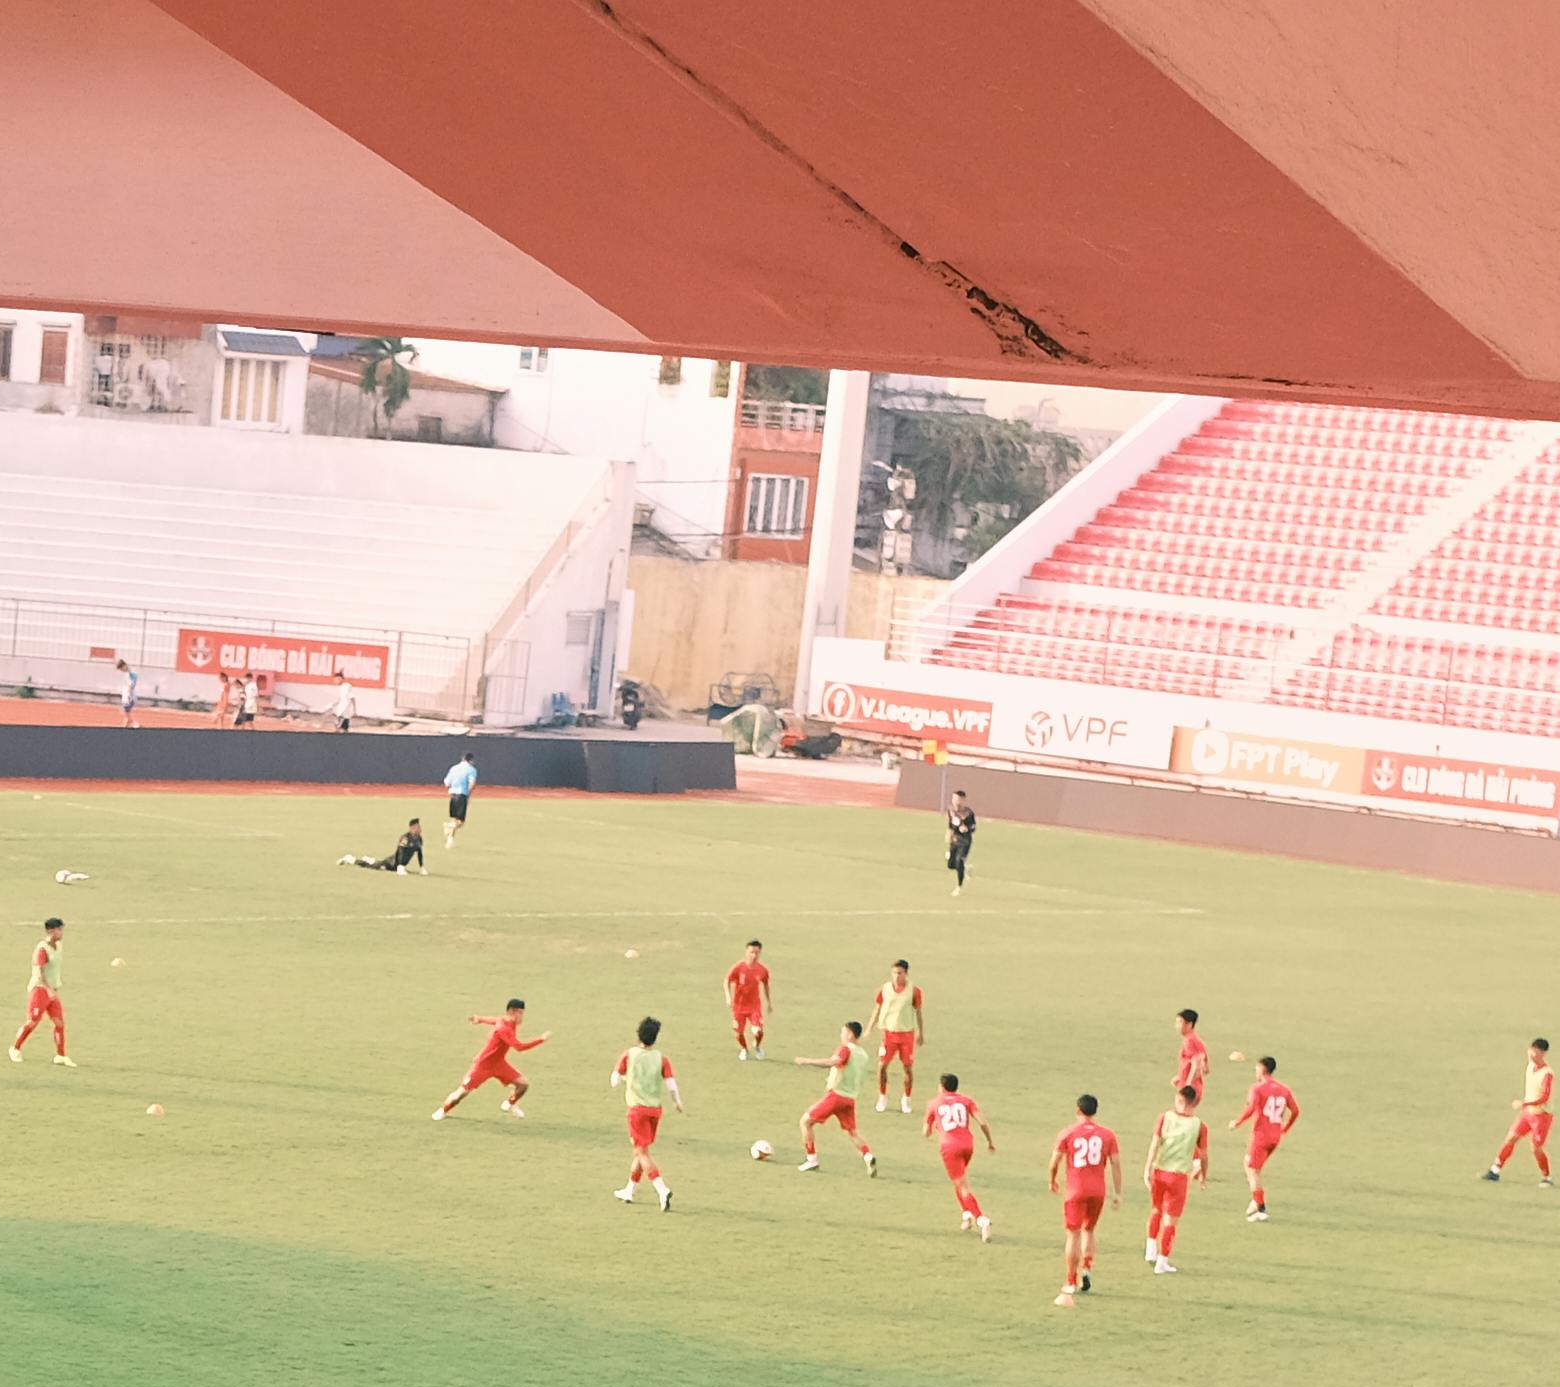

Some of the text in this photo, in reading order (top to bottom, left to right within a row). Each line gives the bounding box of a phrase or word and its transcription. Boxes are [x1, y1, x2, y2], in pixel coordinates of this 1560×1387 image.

[860, 696, 990, 734] V.League.VPF
[1062, 712, 1129, 747] VPF
[1230, 740, 1341, 788] FPT Play
[937, 1102, 968, 1132] 20
[1263, 1096, 1286, 1124] 42
[1073, 1135, 1103, 1168] 28
